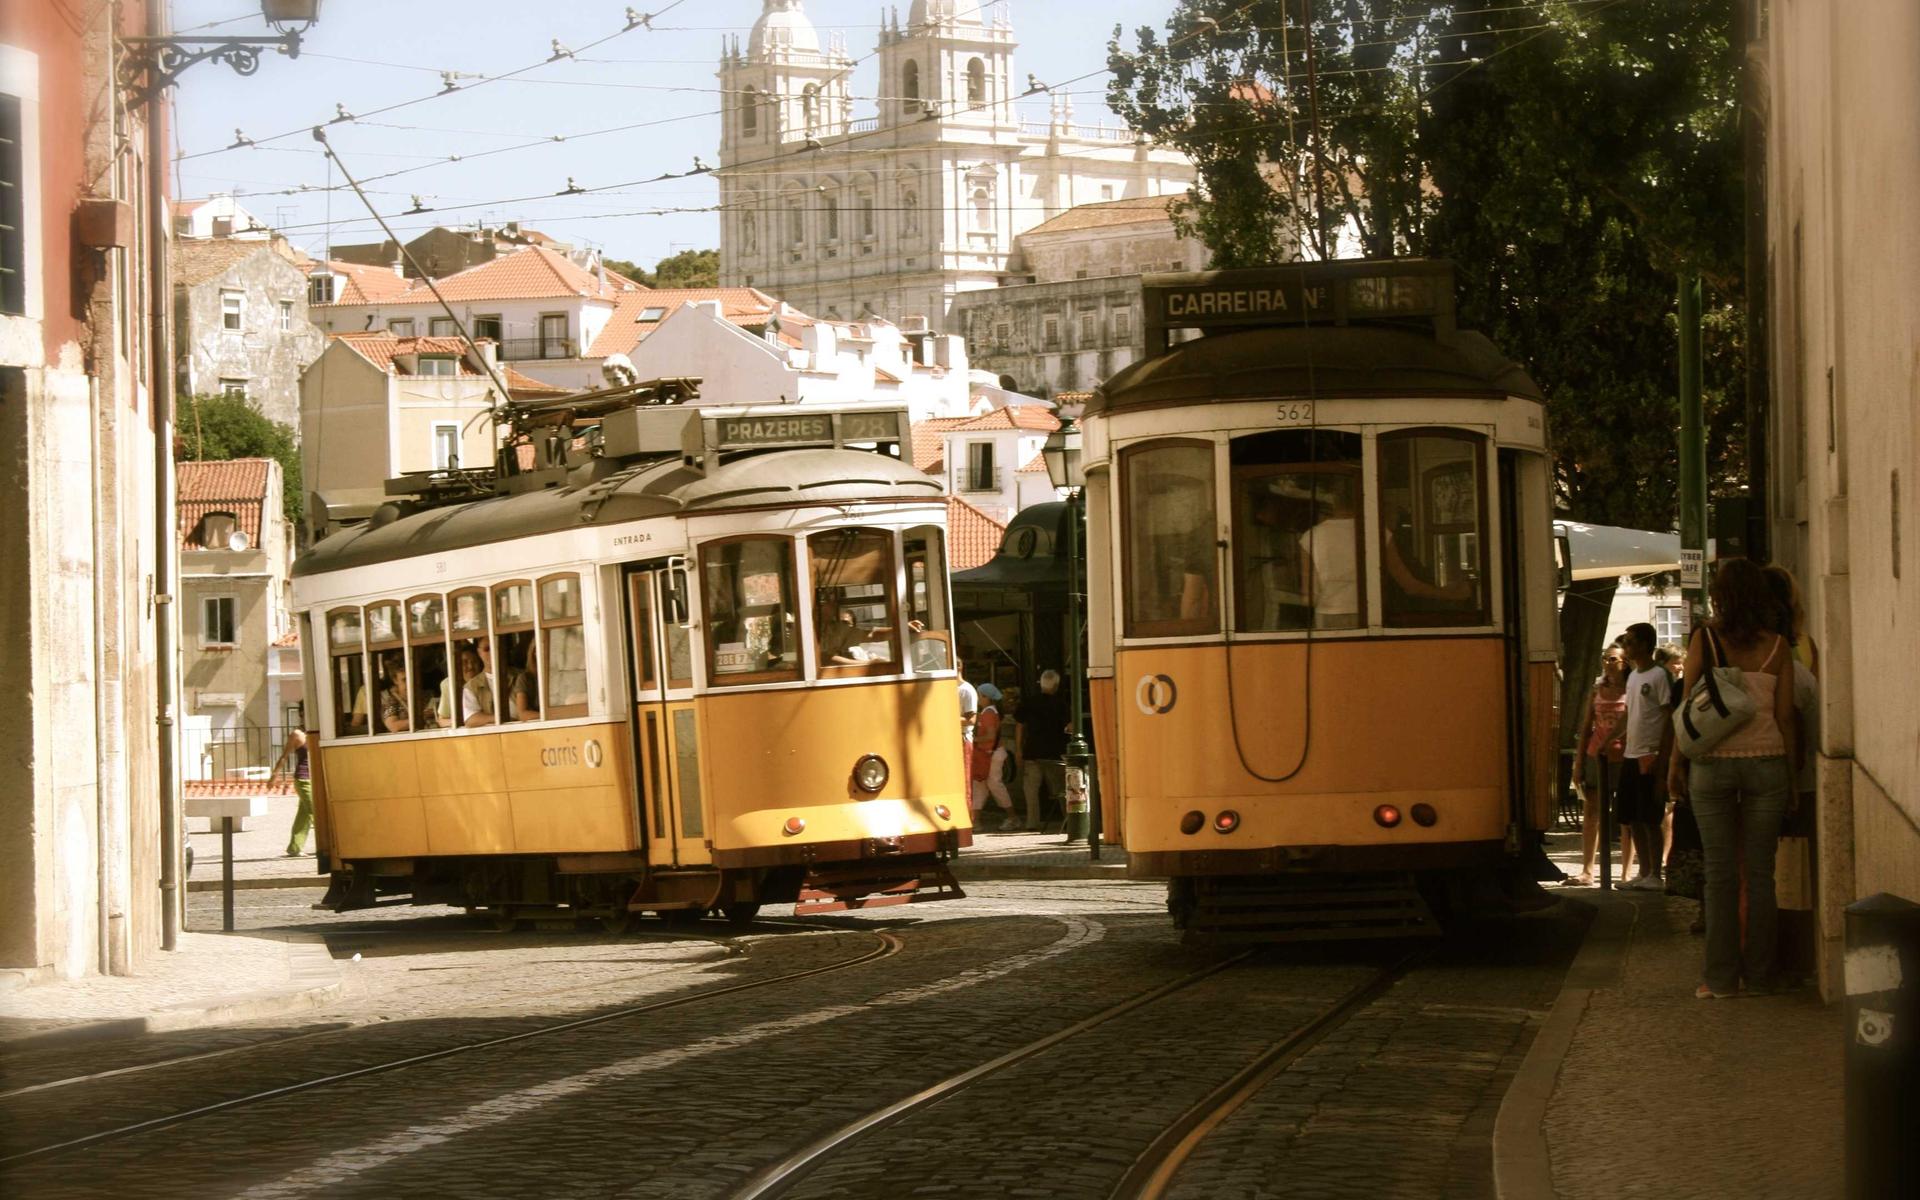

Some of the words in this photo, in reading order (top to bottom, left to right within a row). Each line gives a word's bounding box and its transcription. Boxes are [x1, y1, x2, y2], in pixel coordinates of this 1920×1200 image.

[1168, 289, 1288, 315] CARREIRA
[1277, 404, 1312, 420] 562
[727, 418, 825, 440] PRAZERES
[852, 418, 886, 439] 28
[613, 532, 652, 546] ENTRADA
[541, 738, 577, 766] carris
